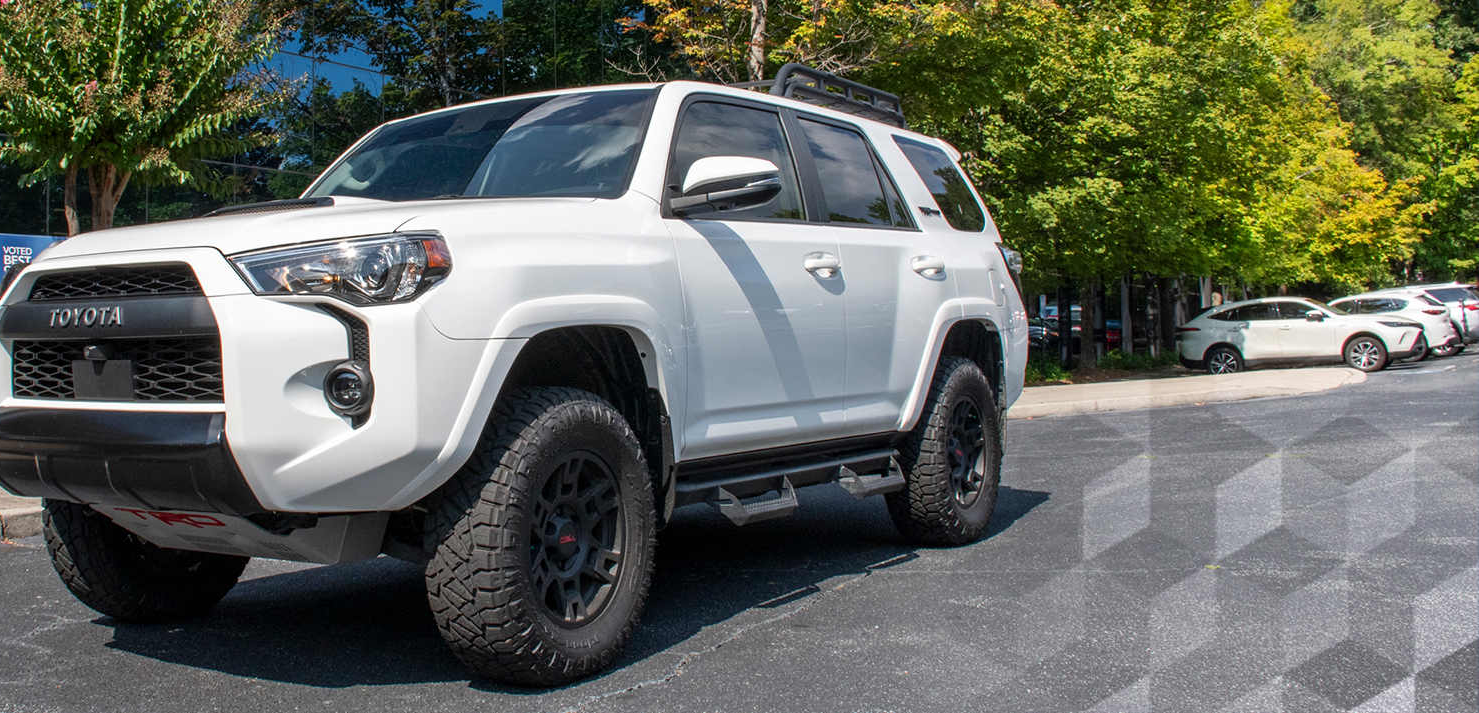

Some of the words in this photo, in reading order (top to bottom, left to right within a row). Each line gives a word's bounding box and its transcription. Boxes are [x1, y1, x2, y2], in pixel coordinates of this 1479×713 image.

[2, 245, 33, 256] VOTED
[3, 254, 32, 266] BEST
[49, 306, 122, 328] TOYOTA
[114, 507, 226, 528] TRD
